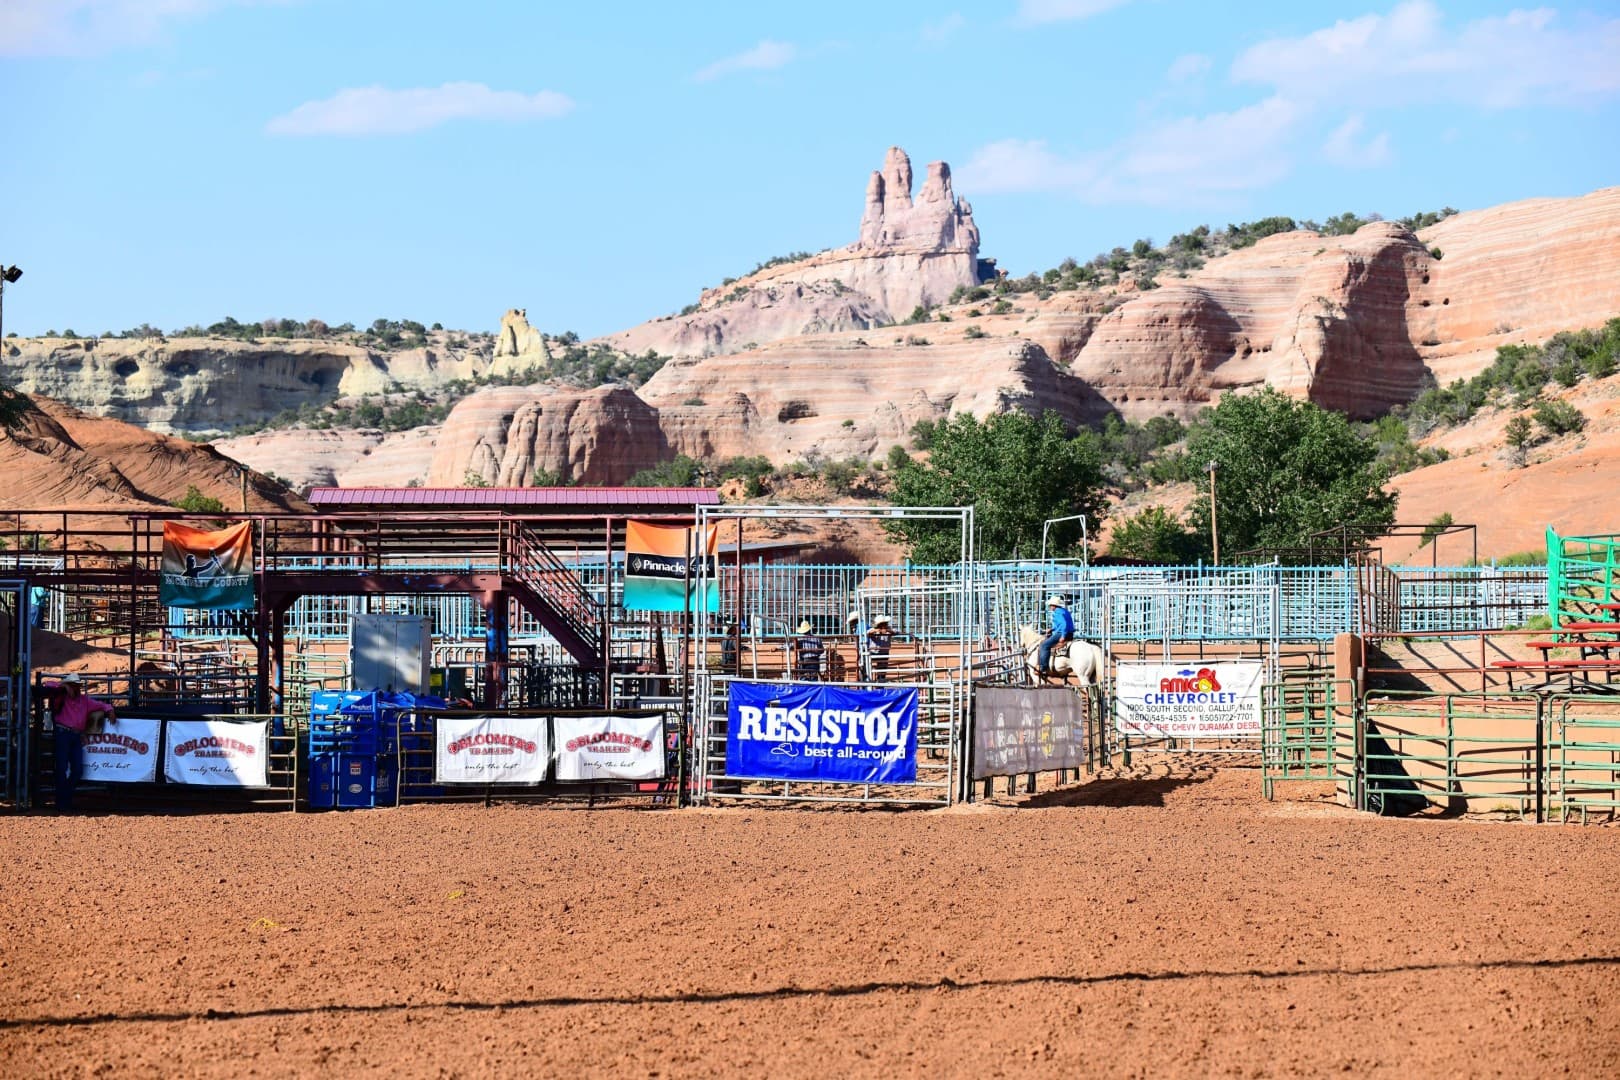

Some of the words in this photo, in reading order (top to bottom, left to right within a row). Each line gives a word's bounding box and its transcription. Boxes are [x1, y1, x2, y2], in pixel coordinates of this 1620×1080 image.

[643, 559, 686, 573] Pinnacle
[1160, 678, 1213, 693] AMIGO
[1144, 692, 1238, 704] CHEVROLET
[1146, 705, 1171, 713] SOUTH
[737, 706, 909, 746] RESISTOL
[1143, 722, 1153, 731] OF
[1156, 723, 1170, 731] THE
[1171, 722, 1196, 731] CHEVY
[1199, 722, 1234, 731] DURAMAX
[1236, 721, 1260, 730] DIESEL
[81, 732, 140, 752] LOOMER
[457, 733, 528, 751] BLOOMER
[576, 732, 643, 750] BLOOMER
[469, 747, 514, 756] TRAILERS
[587, 745, 631, 753] TRAILERS
[804, 745, 833, 758] best
